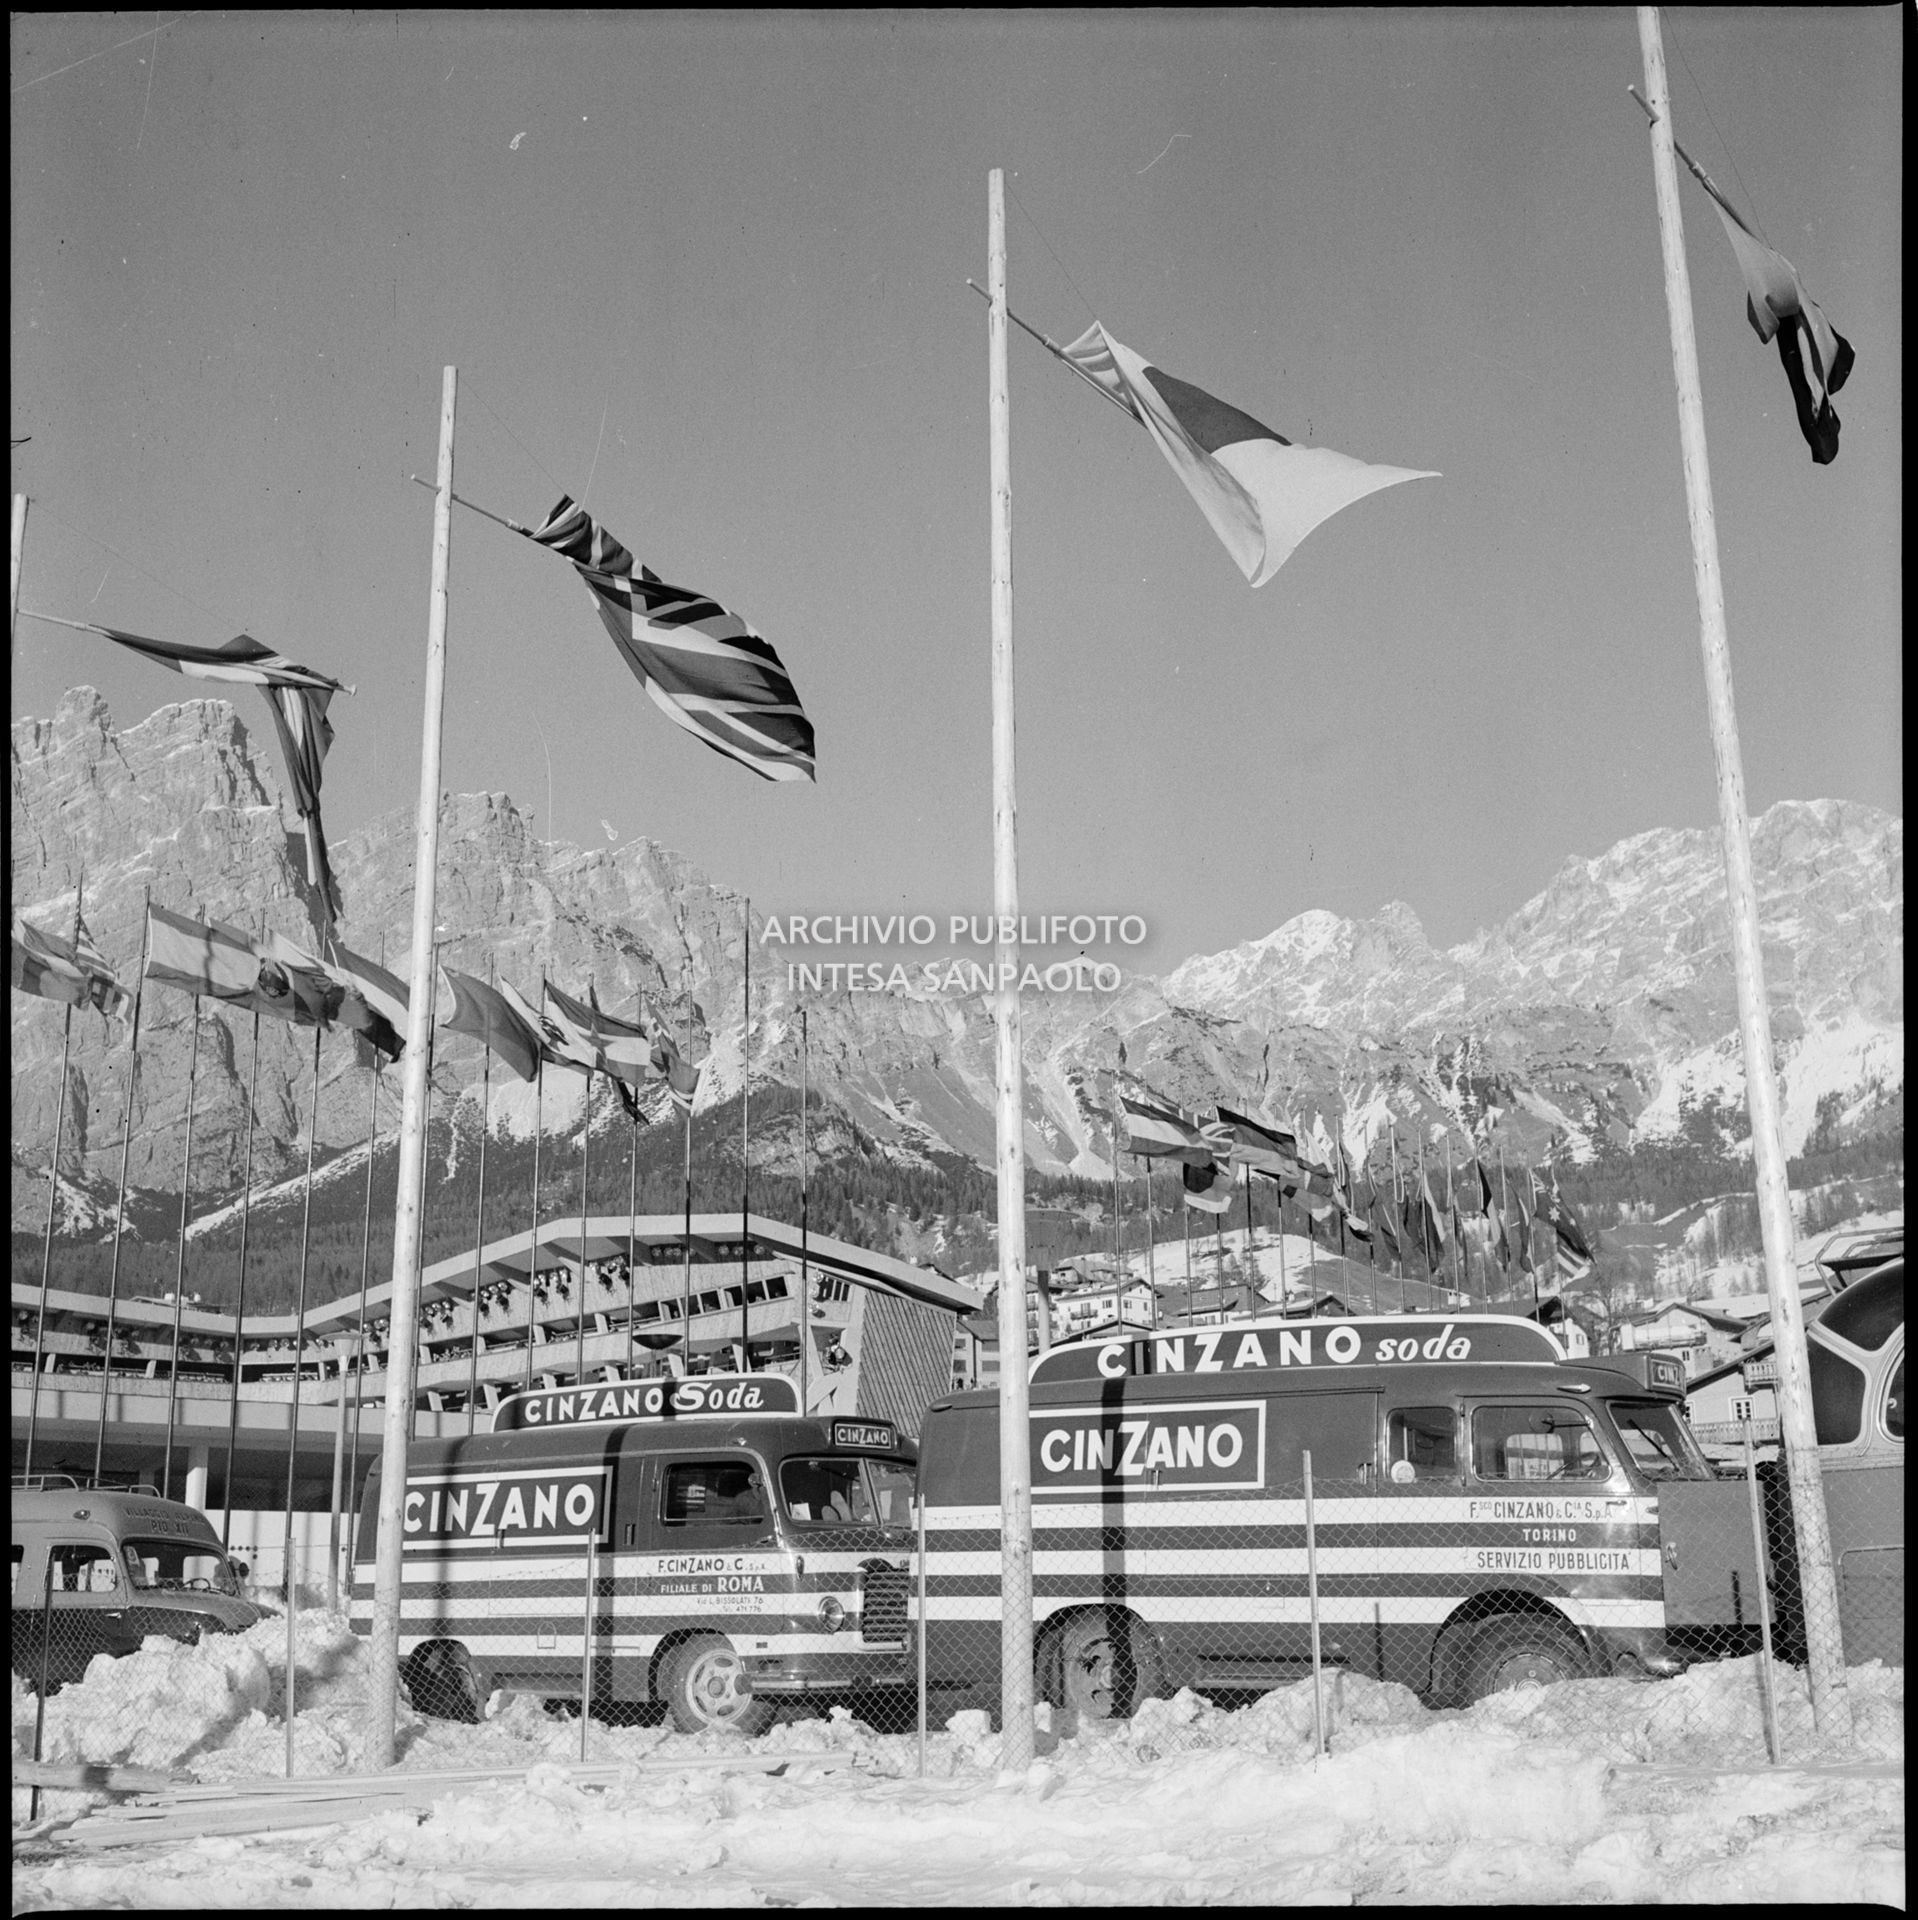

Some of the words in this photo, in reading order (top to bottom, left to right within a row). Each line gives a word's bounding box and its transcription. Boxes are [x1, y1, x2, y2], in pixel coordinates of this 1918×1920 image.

[1097, 1325, 1361, 1378] CINZANO
[1375, 1323, 1472, 1361] soda
[1657, 1364, 1682, 1386] CINZ
[524, 1387, 663, 1423] CINZANO
[669, 1381, 764, 1411] Soda
[837, 1427, 889, 1445] CINZANO
[1040, 1420, 1243, 1476] CINZANO
[404, 1482, 595, 1537] CINZANO
[1494, 1501, 1554, 1519] CINZANO
[1522, 1528, 1577, 1542] TORINO
[1477, 1551, 1542, 1569] SERVIZIO
[660, 1584, 698, 1593] FILIALE
[702, 1584, 712, 1593] DI
[717, 1576, 765, 1592] ROMA
